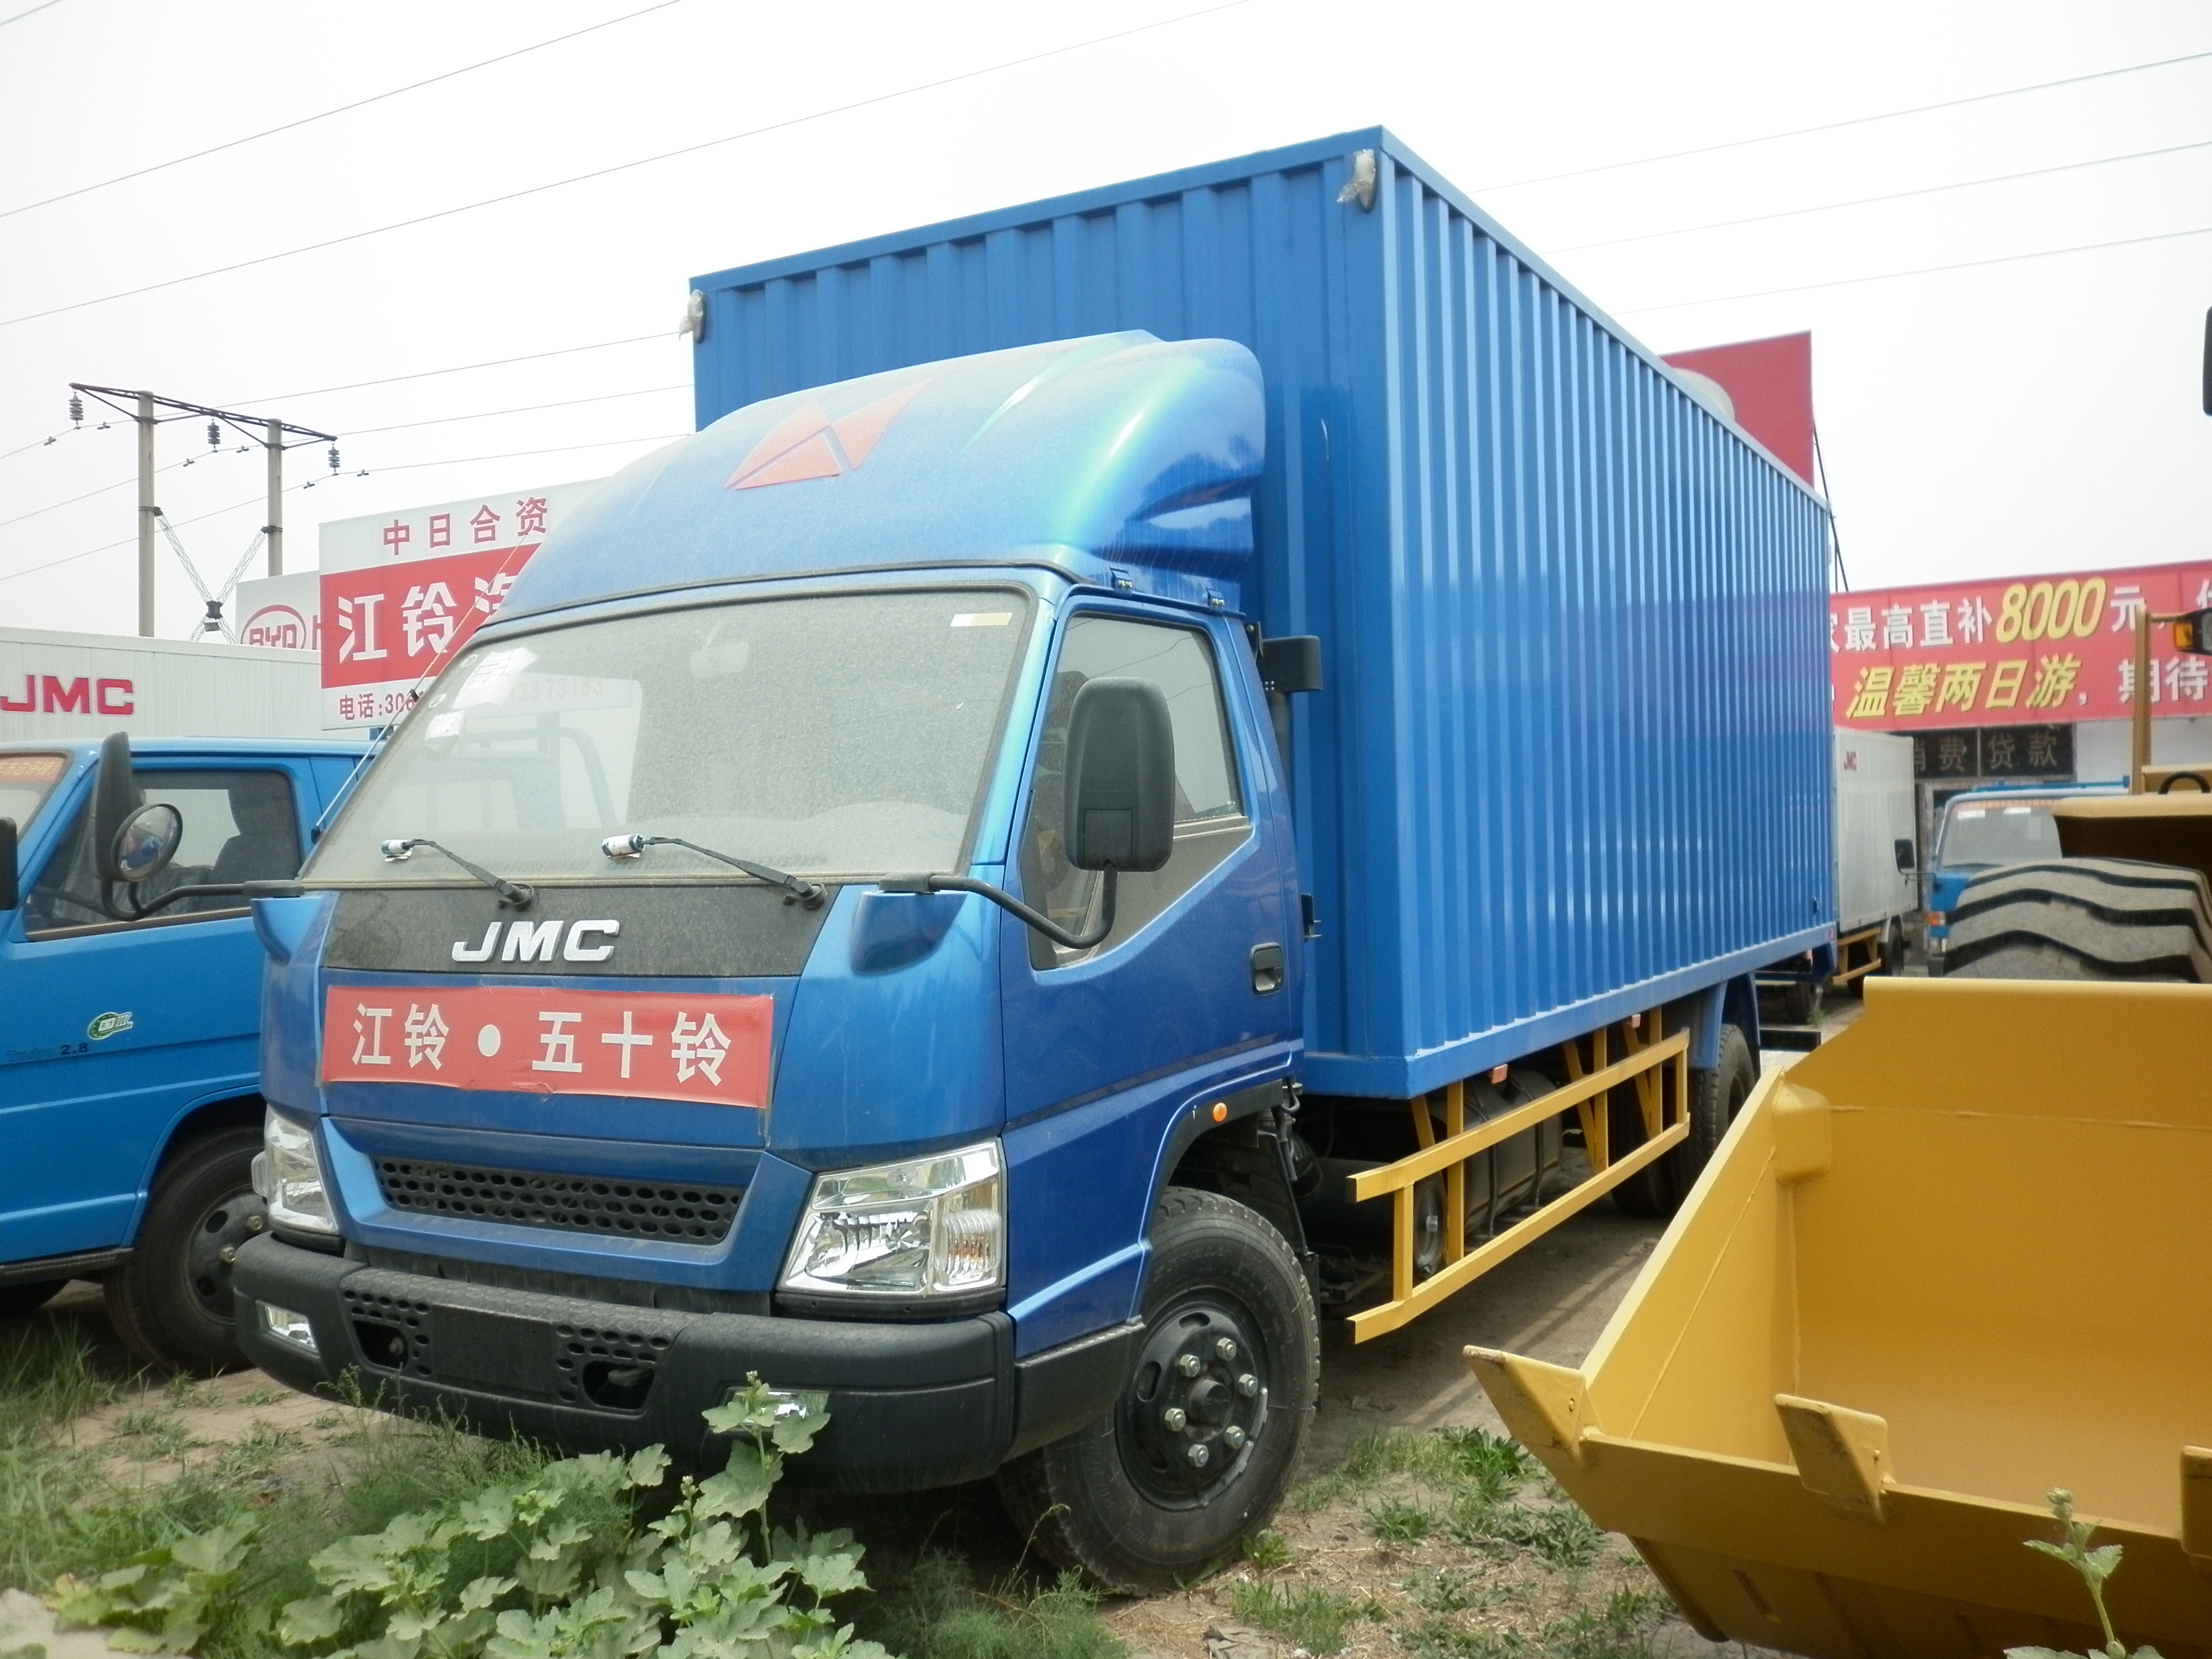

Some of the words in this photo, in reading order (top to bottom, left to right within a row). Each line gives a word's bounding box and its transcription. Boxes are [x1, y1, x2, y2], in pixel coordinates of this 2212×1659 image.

[383, 497, 548, 555] 中日合资
[249, 623, 297, 649] BYD
[0, 674, 134, 716] JMC
[451, 919, 621, 963] JMC
[60, 1042, 89, 1056] 2.8
